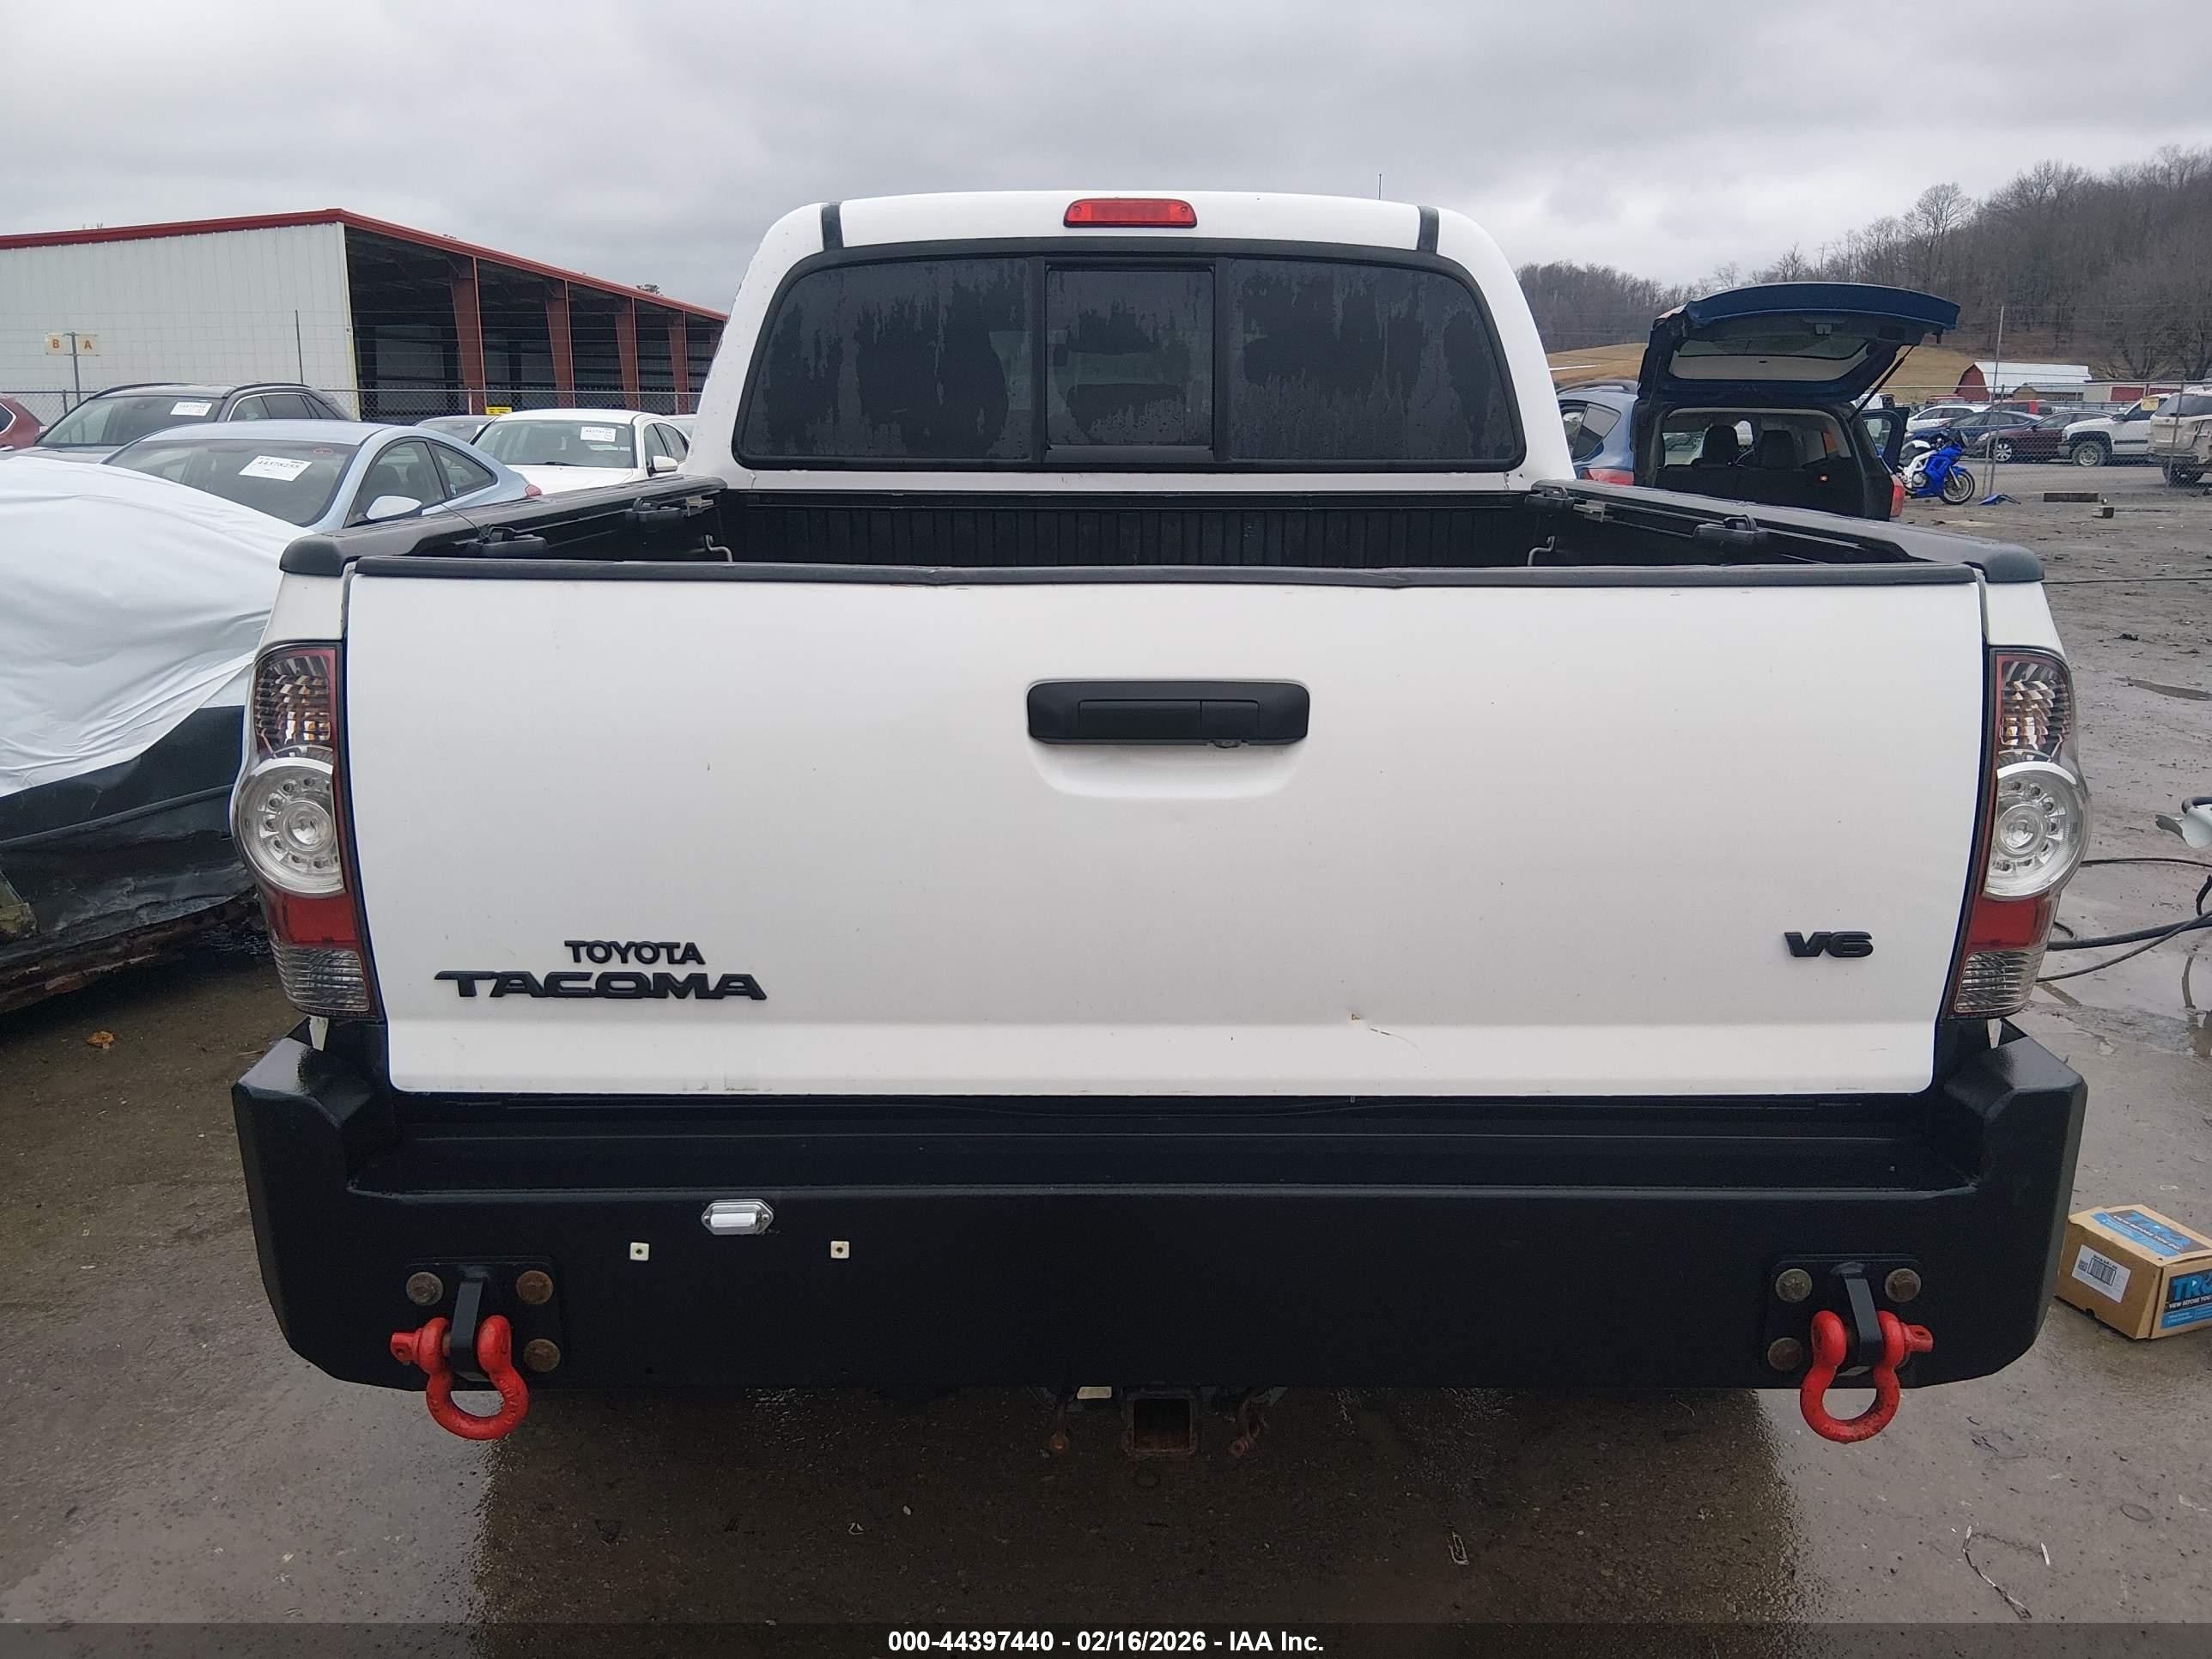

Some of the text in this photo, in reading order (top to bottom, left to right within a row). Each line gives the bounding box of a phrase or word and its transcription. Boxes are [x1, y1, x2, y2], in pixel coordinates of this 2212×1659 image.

[52, 339, 60, 349] B
[84, 340, 93, 349] A
[564, 940, 706, 965] TOYOTA
[1784, 931, 1874, 957] V6
[434, 970, 768, 1000] TACOMA
